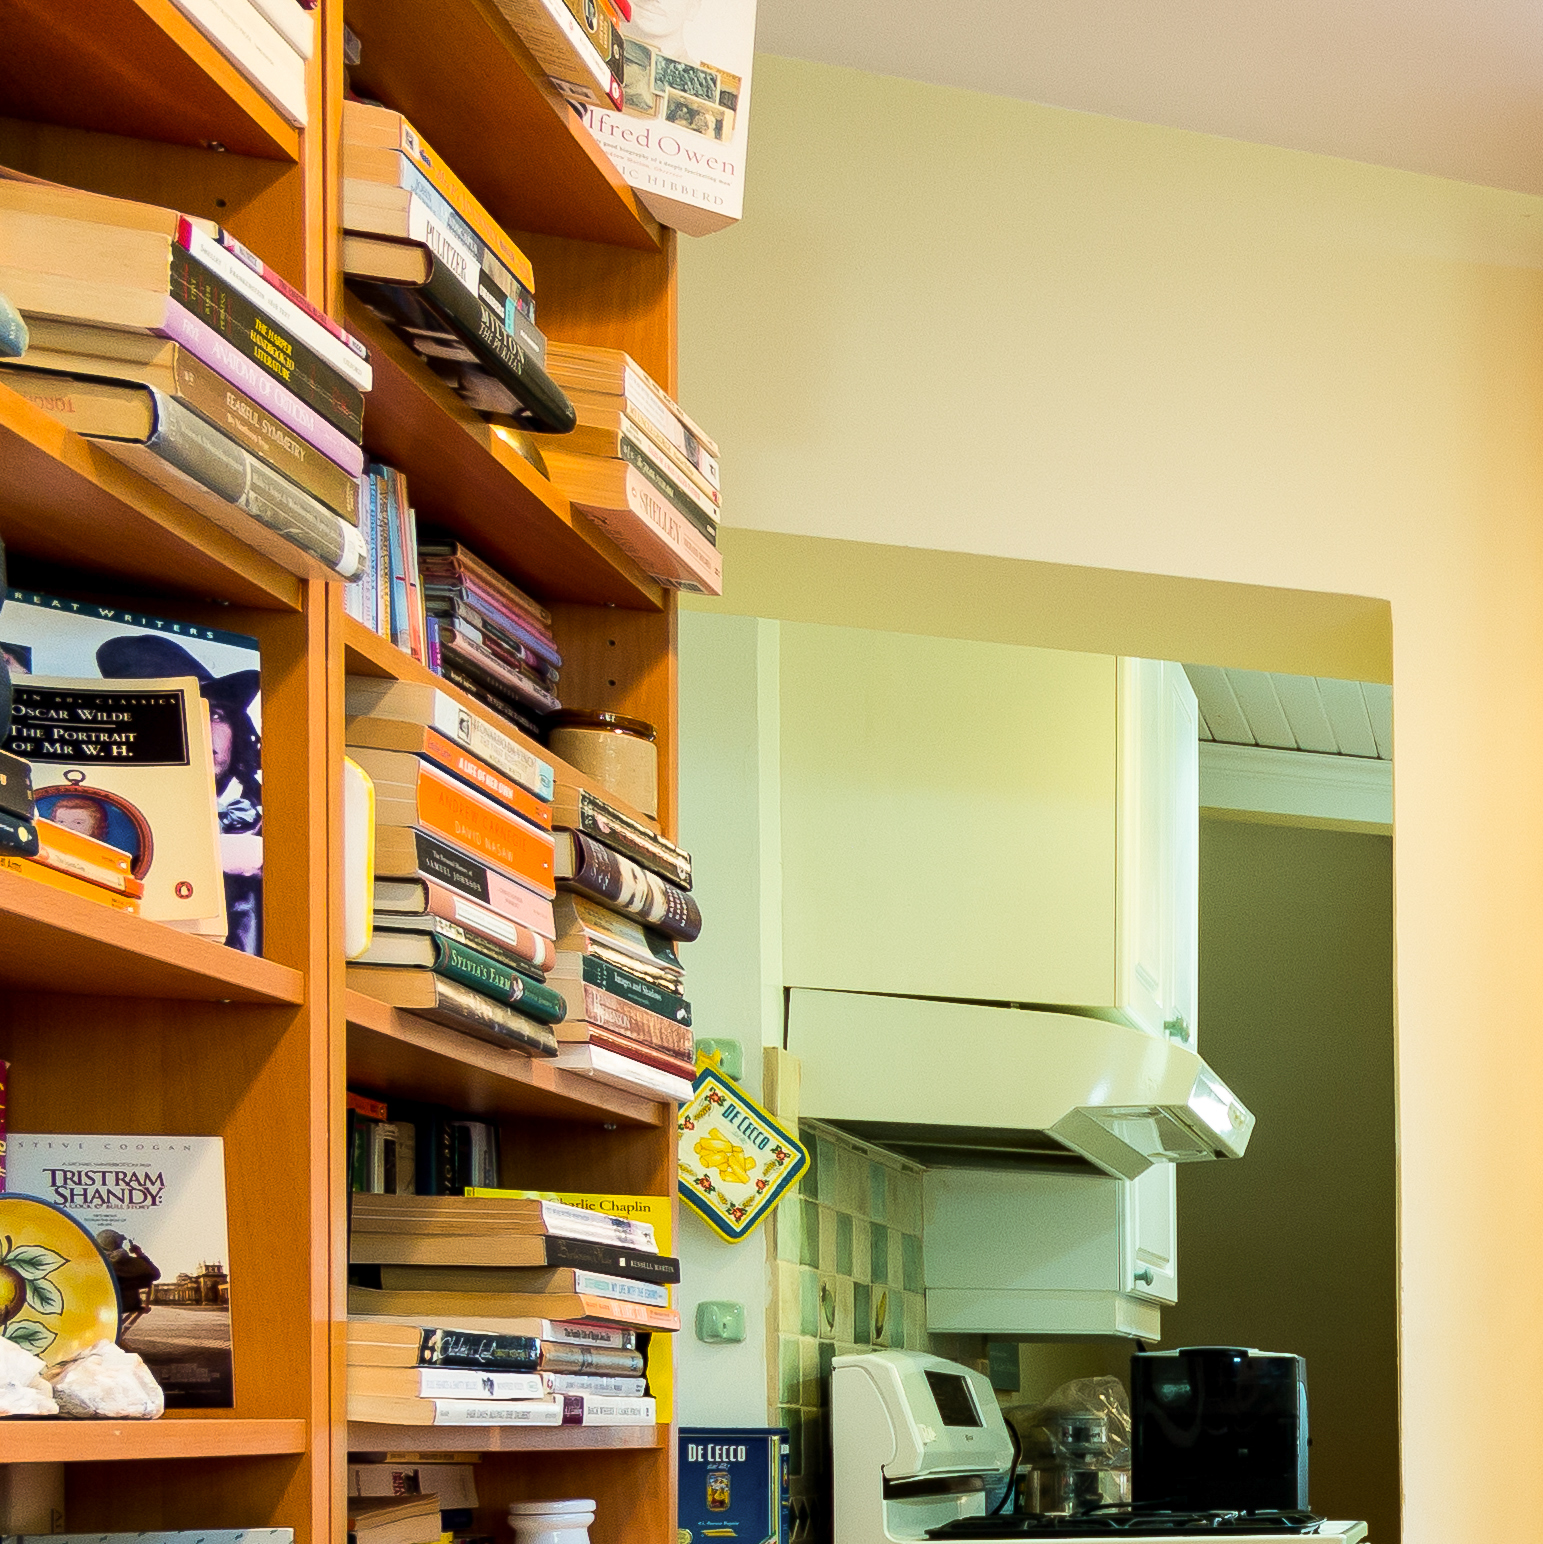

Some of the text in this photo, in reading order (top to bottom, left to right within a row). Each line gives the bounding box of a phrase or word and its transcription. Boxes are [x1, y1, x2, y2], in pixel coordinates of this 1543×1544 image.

[658, 136, 735, 176] Owen
[425, 219, 467, 283] PULITZER
[640, 490, 681, 545] SHELLEY
[99, 608, 214, 639] WRITERS
[11, 704, 132, 722] OSCAR WILDE
[11, 725, 137, 742] THE PORTRAIT
[12, 742, 134, 757] OF MR W. H.
[451, 949, 511, 992] SYLVIA'S FARM
[721, 1103, 770, 1151] DE CECCO
[43, 1168, 165, 1188] TRISTRAM
[599, 1198, 651, 1214] Chaplin
[688, 1443, 747, 1463] DE CECCO
